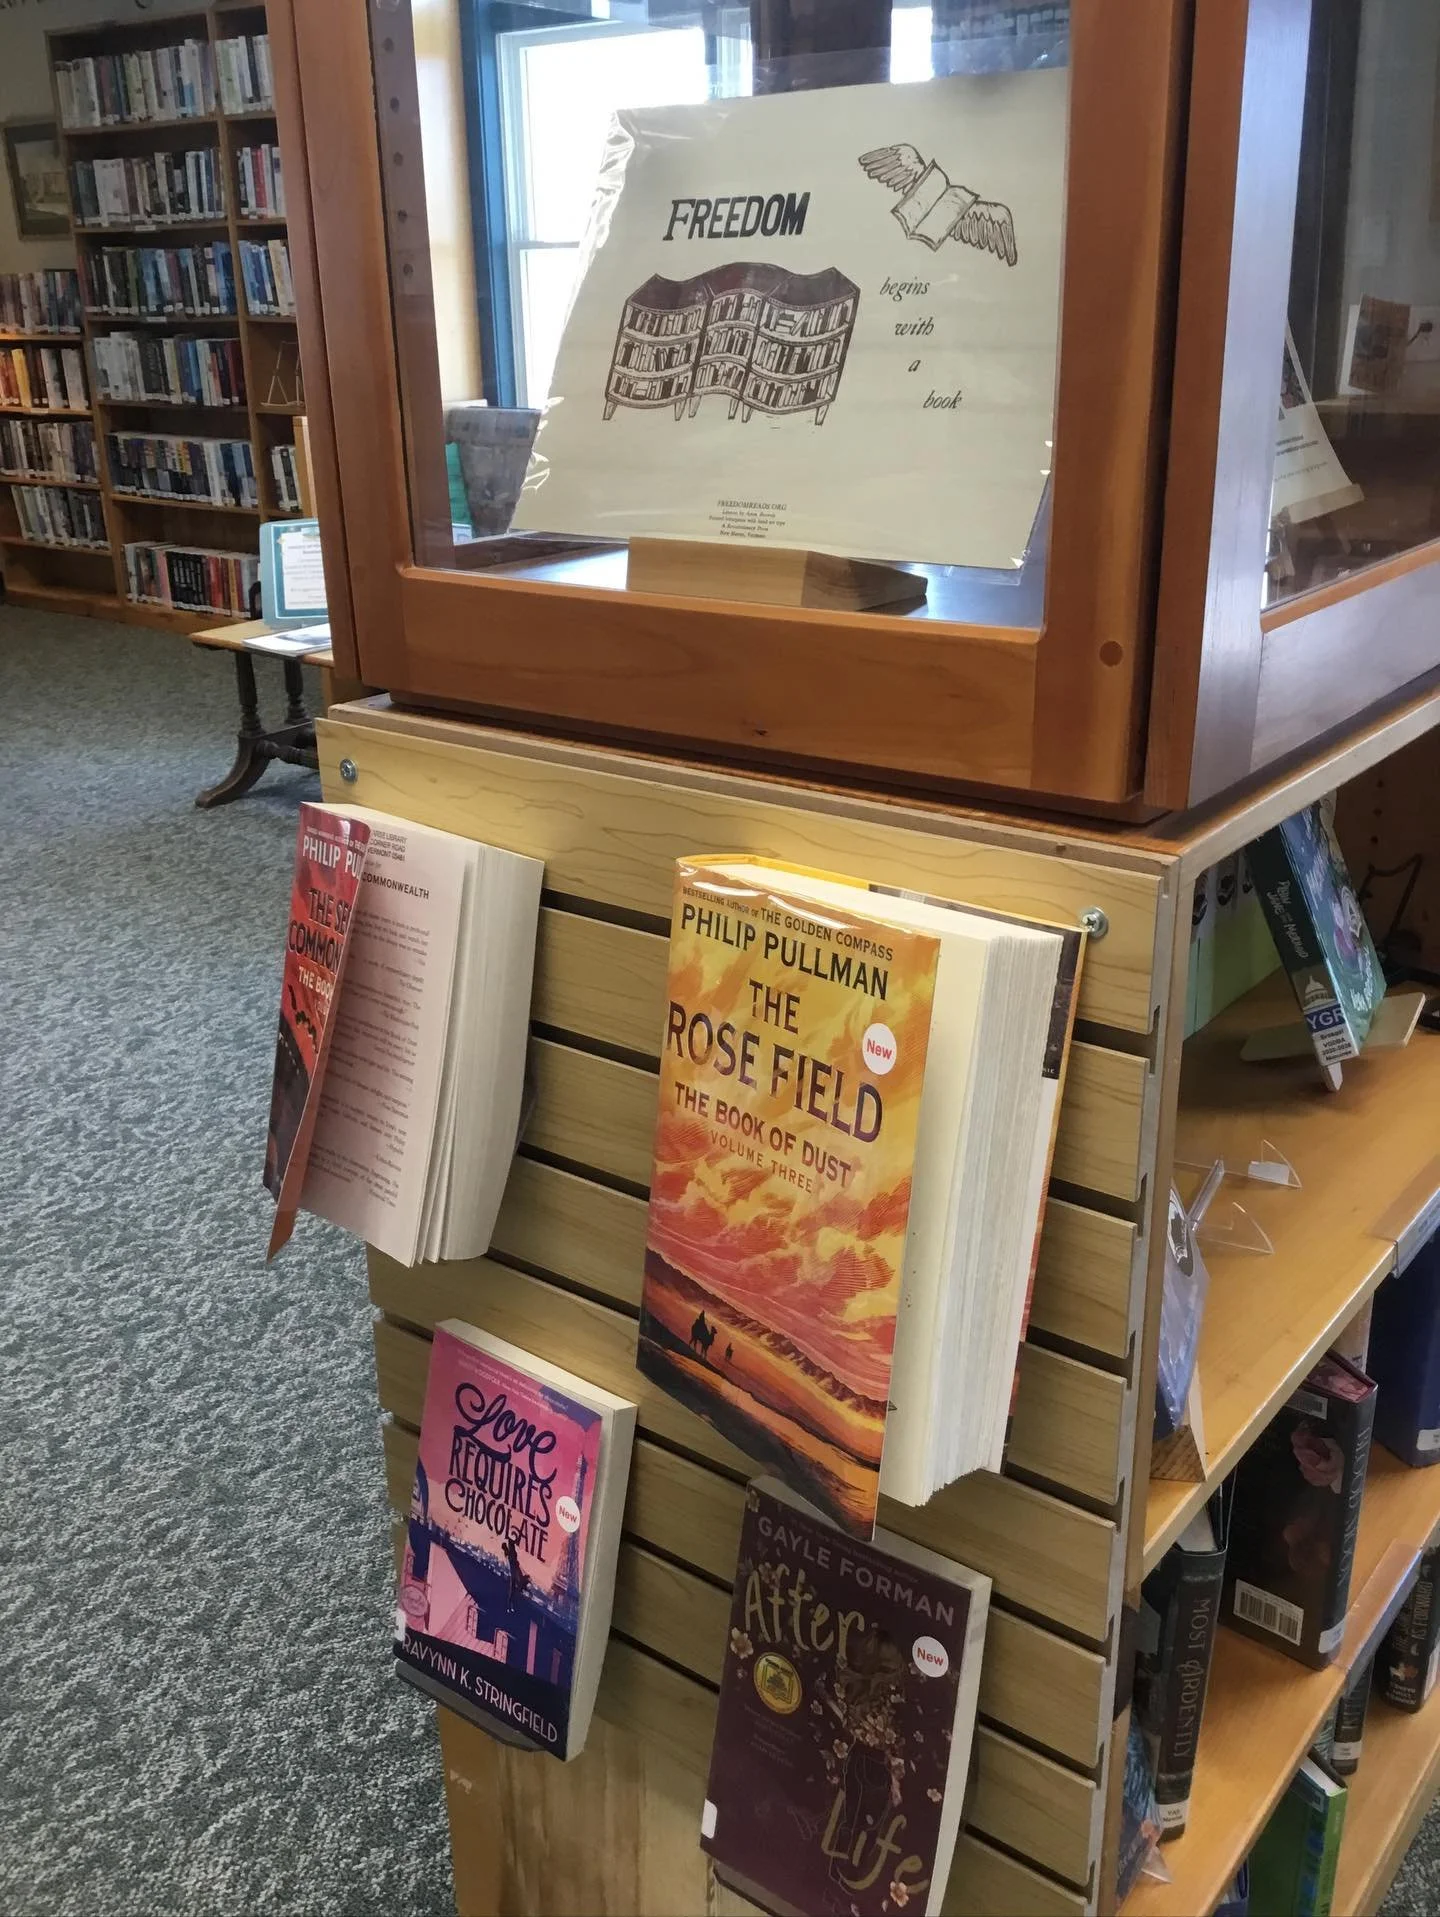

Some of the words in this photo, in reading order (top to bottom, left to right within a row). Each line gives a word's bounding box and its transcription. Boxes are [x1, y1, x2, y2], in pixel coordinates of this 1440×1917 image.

[662, 192, 811, 241] FREEDOM
[880, 276, 930, 301] begins
[894, 317, 934, 336] with
[908, 359, 921, 372] a
[923, 390, 962, 409] book
[302, 834, 341, 869] PHILIP
[309, 887, 334, 928] THE
[362, 871, 430, 900] COMMONWEALTH
[682, 886, 725, 907] BESTSELLING
[726, 897, 750, 915] AUTHOR
[751, 908, 758, 919] OF
[760, 907, 781, 929] THE
[785, 915, 832, 942] GOLDEN
[835, 931, 894, 962] COMPASS
[299, 966, 315, 990] THE
[681, 903, 756, 951] PHILIP
[763, 931, 889, 1001] PULLMAN
[749, 979, 800, 1035] THE
[666, 1000, 760, 1090] ROSE
[769, 1042, 883, 1143] FIELD
[866, 1038, 893, 1061] New
[674, 1081, 710, 1119] THE
[715, 1098, 765, 1144] BOOK
[769, 1126, 797, 1156] OF
[801, 1140, 851, 1188] DUST
[711, 1130, 764, 1168] VOLUME
[771, 1159, 814, 1194] THREE
[449, 1432, 553, 1528] REQUIRES
[444, 1478, 549, 1563] CHOCOLATE
[558, 1505, 578, 1524] New
[758, 1515, 831, 1570] GAYLE
[839, 1557, 955, 1627] FORMAN
[744, 1562, 866, 1669] After
[1188, 1598, 1211, 1650] MOST
[916, 1646, 944, 1667] New
[402, 1633, 457, 1681] RAVYNN
[460, 1666, 472, 1690] K.
[475, 1676, 558, 1743] STRINGFIELD
[1174, 1659, 1205, 1759] ARDENTLY
[820, 1788, 929, 1892] Life
